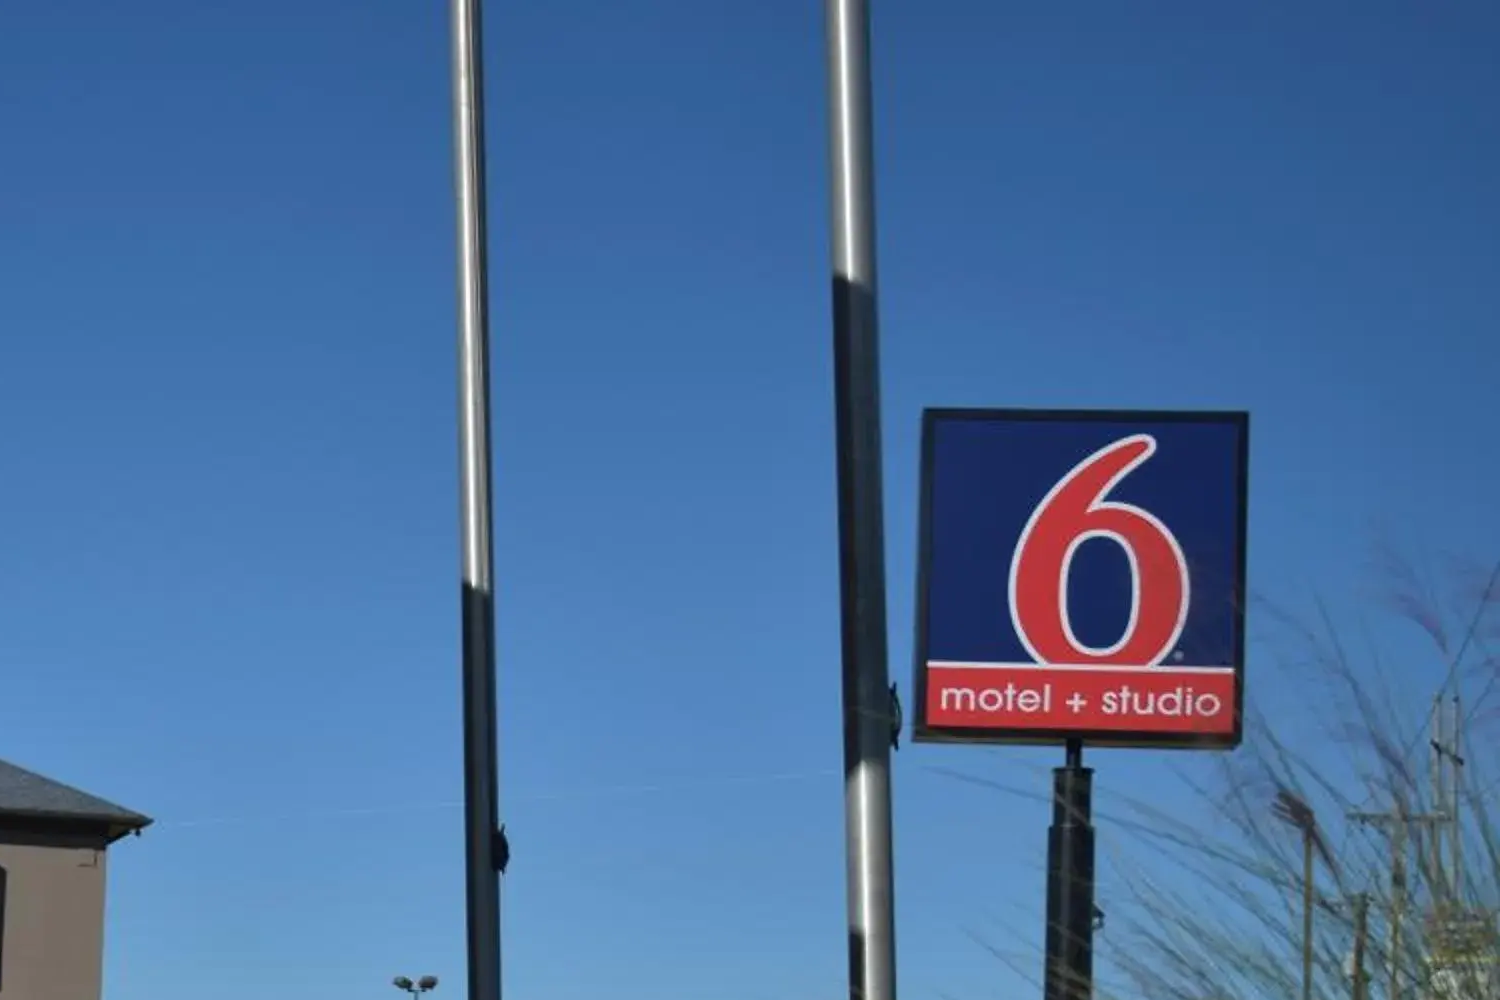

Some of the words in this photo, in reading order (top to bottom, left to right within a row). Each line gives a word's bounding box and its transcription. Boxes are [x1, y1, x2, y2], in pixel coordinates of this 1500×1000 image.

[1008, 433, 1191, 669] 6
[940, 683, 1052, 713] motel
[1101, 684, 1222, 718] studio
